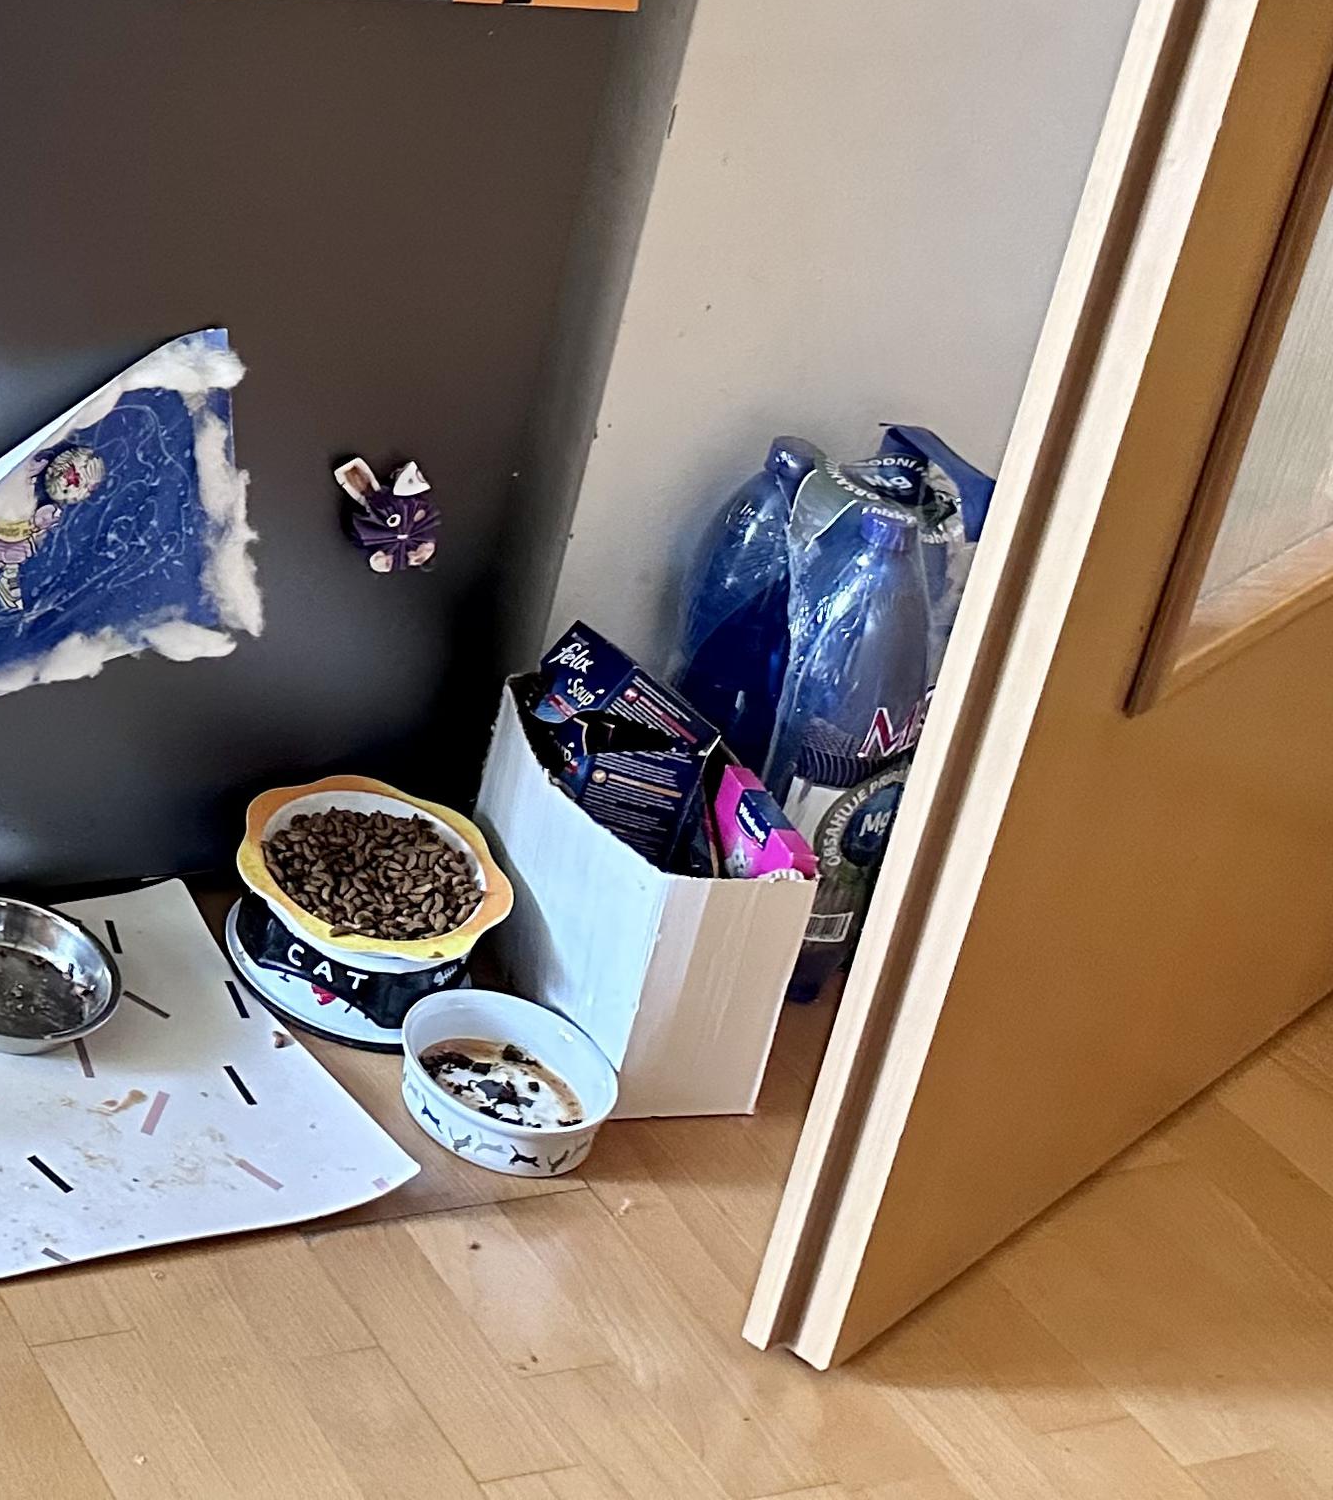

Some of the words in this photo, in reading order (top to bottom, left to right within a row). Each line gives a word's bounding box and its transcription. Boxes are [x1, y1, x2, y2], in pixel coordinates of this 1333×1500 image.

[860, 474, 914, 490] Mg
[823, 788, 868, 867] OBSAHUJE
[286, 942, 370, 990] CAT
